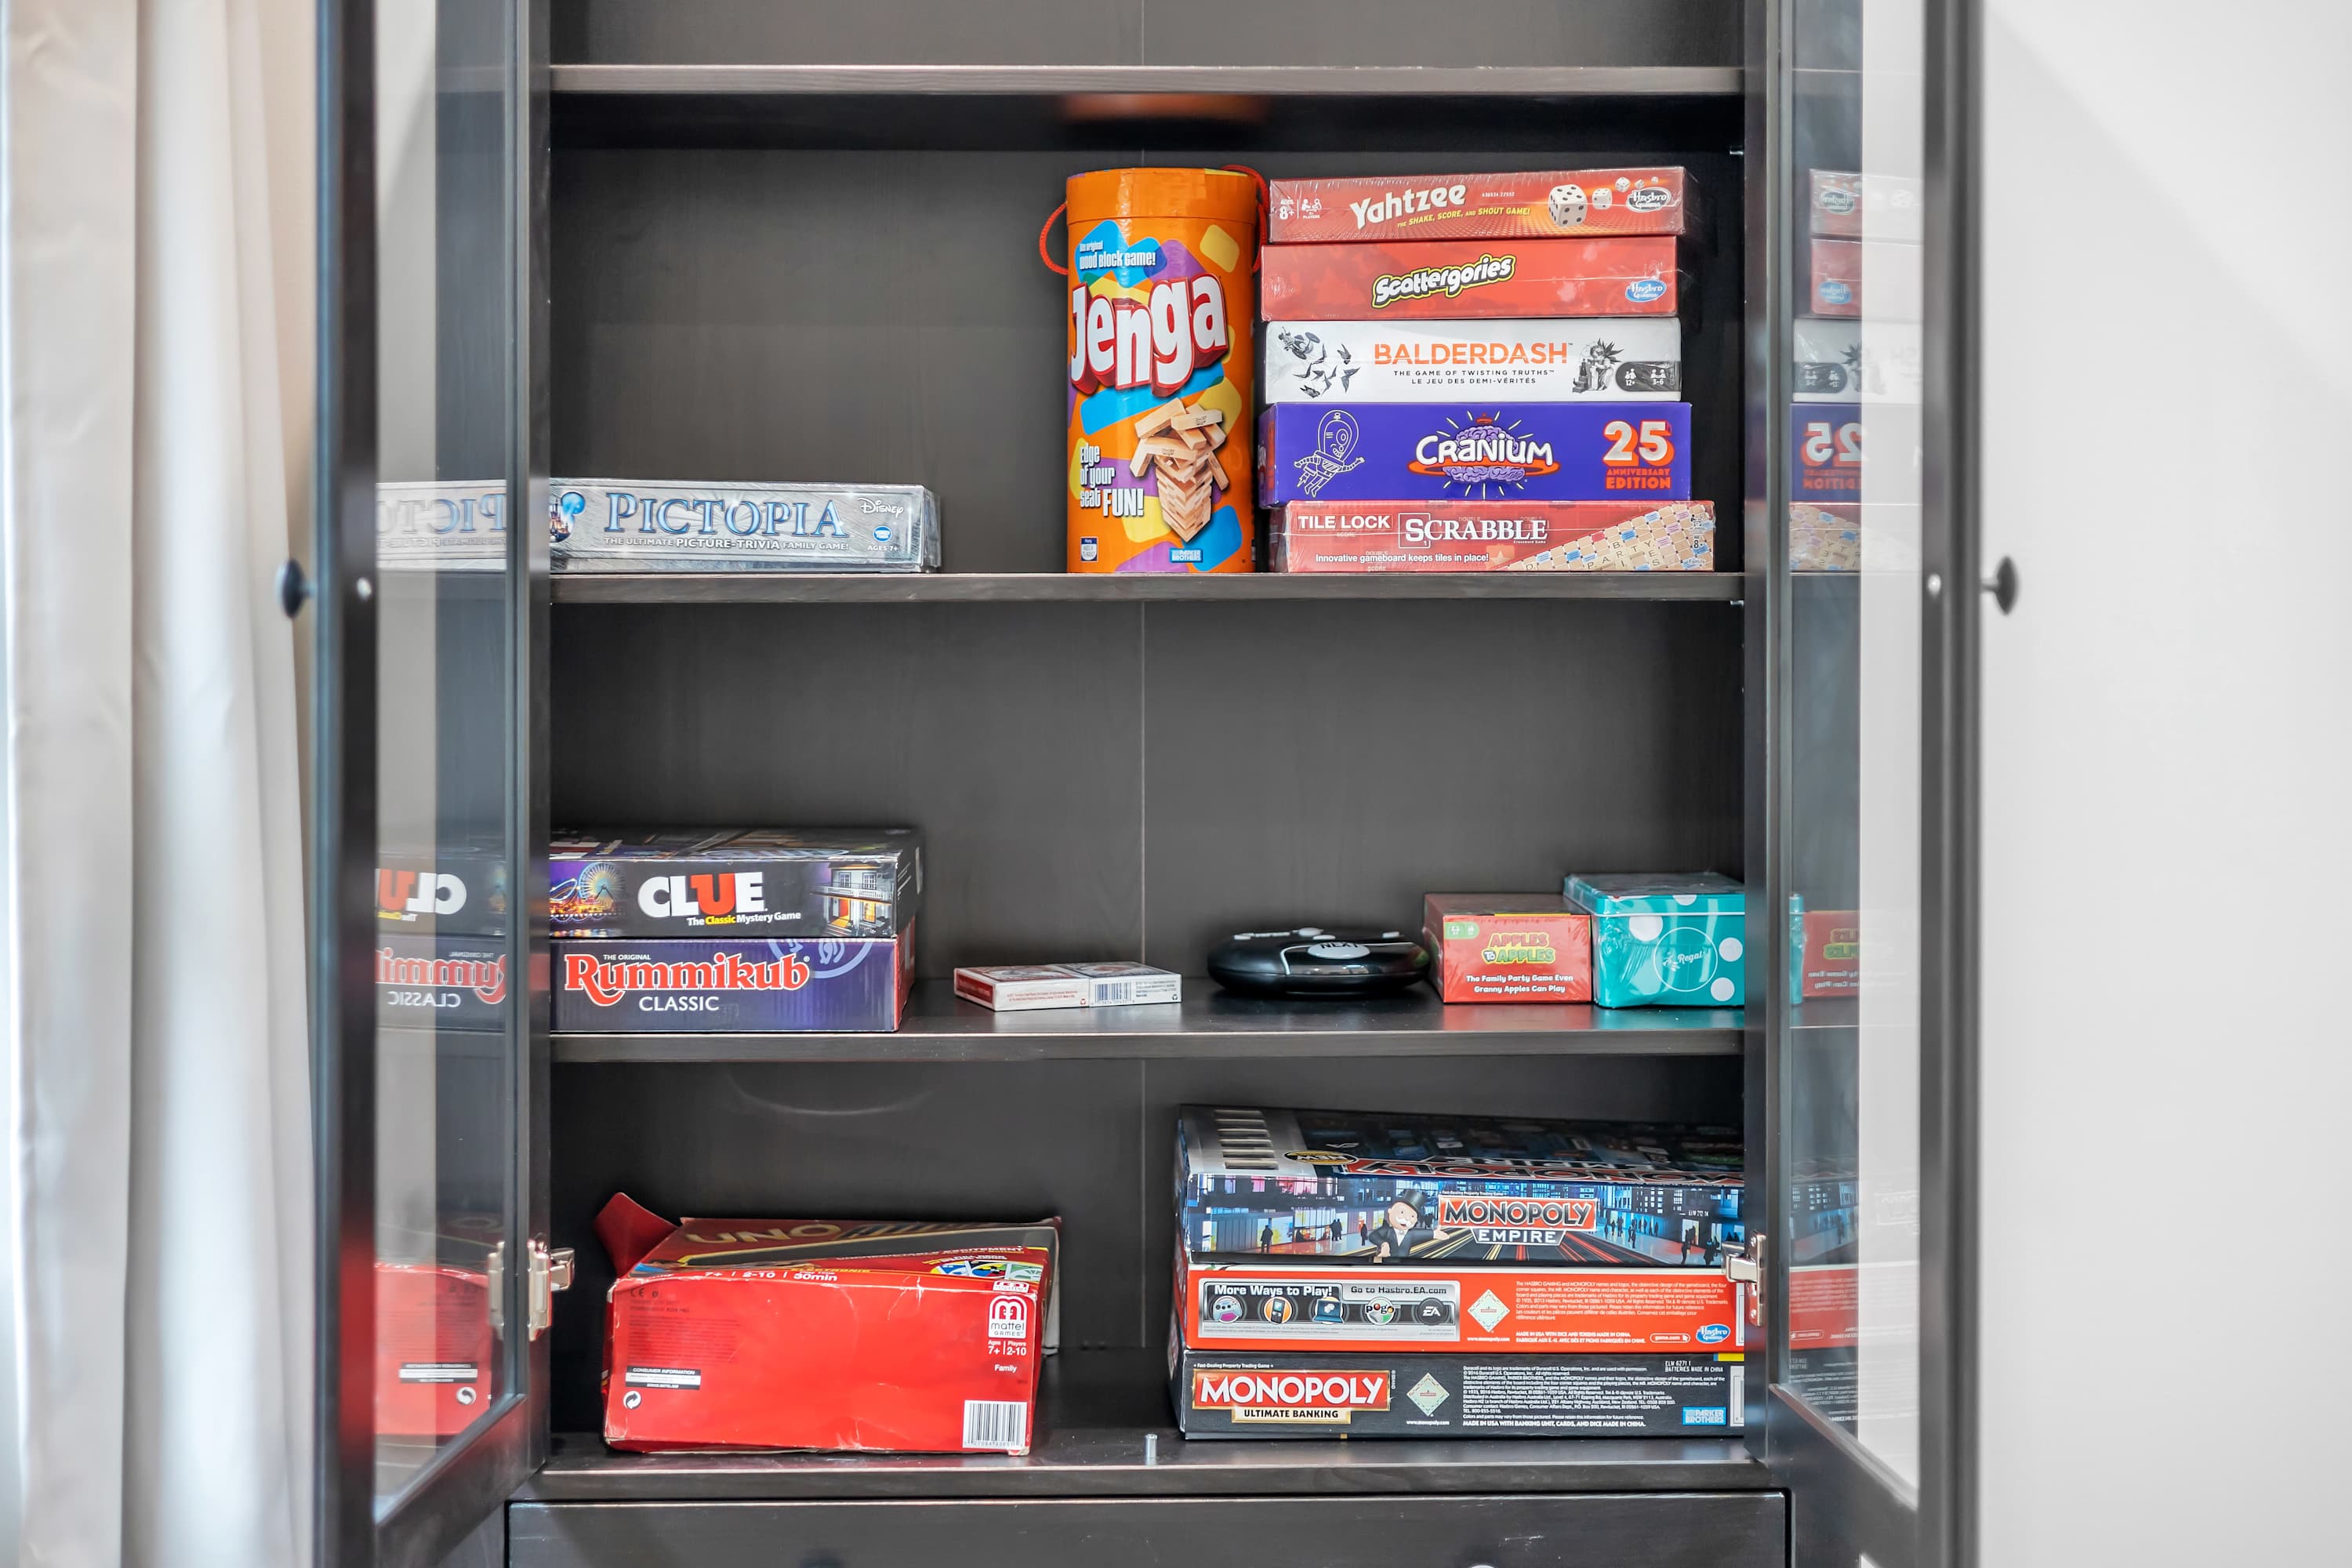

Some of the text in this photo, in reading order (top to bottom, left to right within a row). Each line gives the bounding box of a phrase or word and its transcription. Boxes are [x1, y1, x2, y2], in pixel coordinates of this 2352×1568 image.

[1279, 205, 1294, 220] 8+
[1349, 184, 1467, 230] Yahtzee
[1408, 214, 1436, 226] SHAKE,
[1437, 210, 1463, 220] SCORE,
[1478, 207, 1504, 216] SHOUT
[1374, 256, 1514, 306] Scattergories
[1071, 276, 1228, 390] Jenga
[1603, 420, 1675, 466] 25
[1089, 467, 1115, 488] your
[1606, 477, 1671, 489] EDITION
[1080, 487, 1144, 517] seat FUN!
[604, 492, 850, 538] PICTOPIA
[1298, 515, 1390, 529] TILE LOCK
[1405, 518, 1548, 542] SCRABBLE
[604, 537, 850, 550] THE ULTIMATE PICTURE-TRIVIA FAMILY GAME!
[1316, 554, 1489, 564] Innovative gameboard keeps tiles in place!
[637, 871, 768, 918] CLUE
[688, 911, 801, 927] The Classic Mystery Game
[1490, 933, 1548, 948] APPLES
[1496, 949, 1555, 963] APPLES
[1678, 950, 1702, 964] Regal
[1482, 975, 1506, 984] Family
[1508, 975, 1530, 984] Party
[1474, 985, 1502, 994] Granny
[1504, 985, 1530, 994] Apples
[639, 996, 720, 1011] CLASSIC
[1444, 1200, 1592, 1228] MONOPOLY
[686, 1224, 841, 1244] UNO
[1478, 1229, 1556, 1243] EMPIRE
[793, 1272, 837, 1282] 30min
[1215, 1286, 1332, 1297] More Ways to Play!
[1366, 1303, 1395, 1315] pogo
[1424, 1307, 1441, 1316] EA
[991, 1322, 1024, 1330] mattel
[988, 1346, 1026, 1356] 7+ 2-10
[1200, 1375, 1384, 1404] MONOPOLY
[1243, 1410, 1338, 1418] ULTIMATE BANKING
